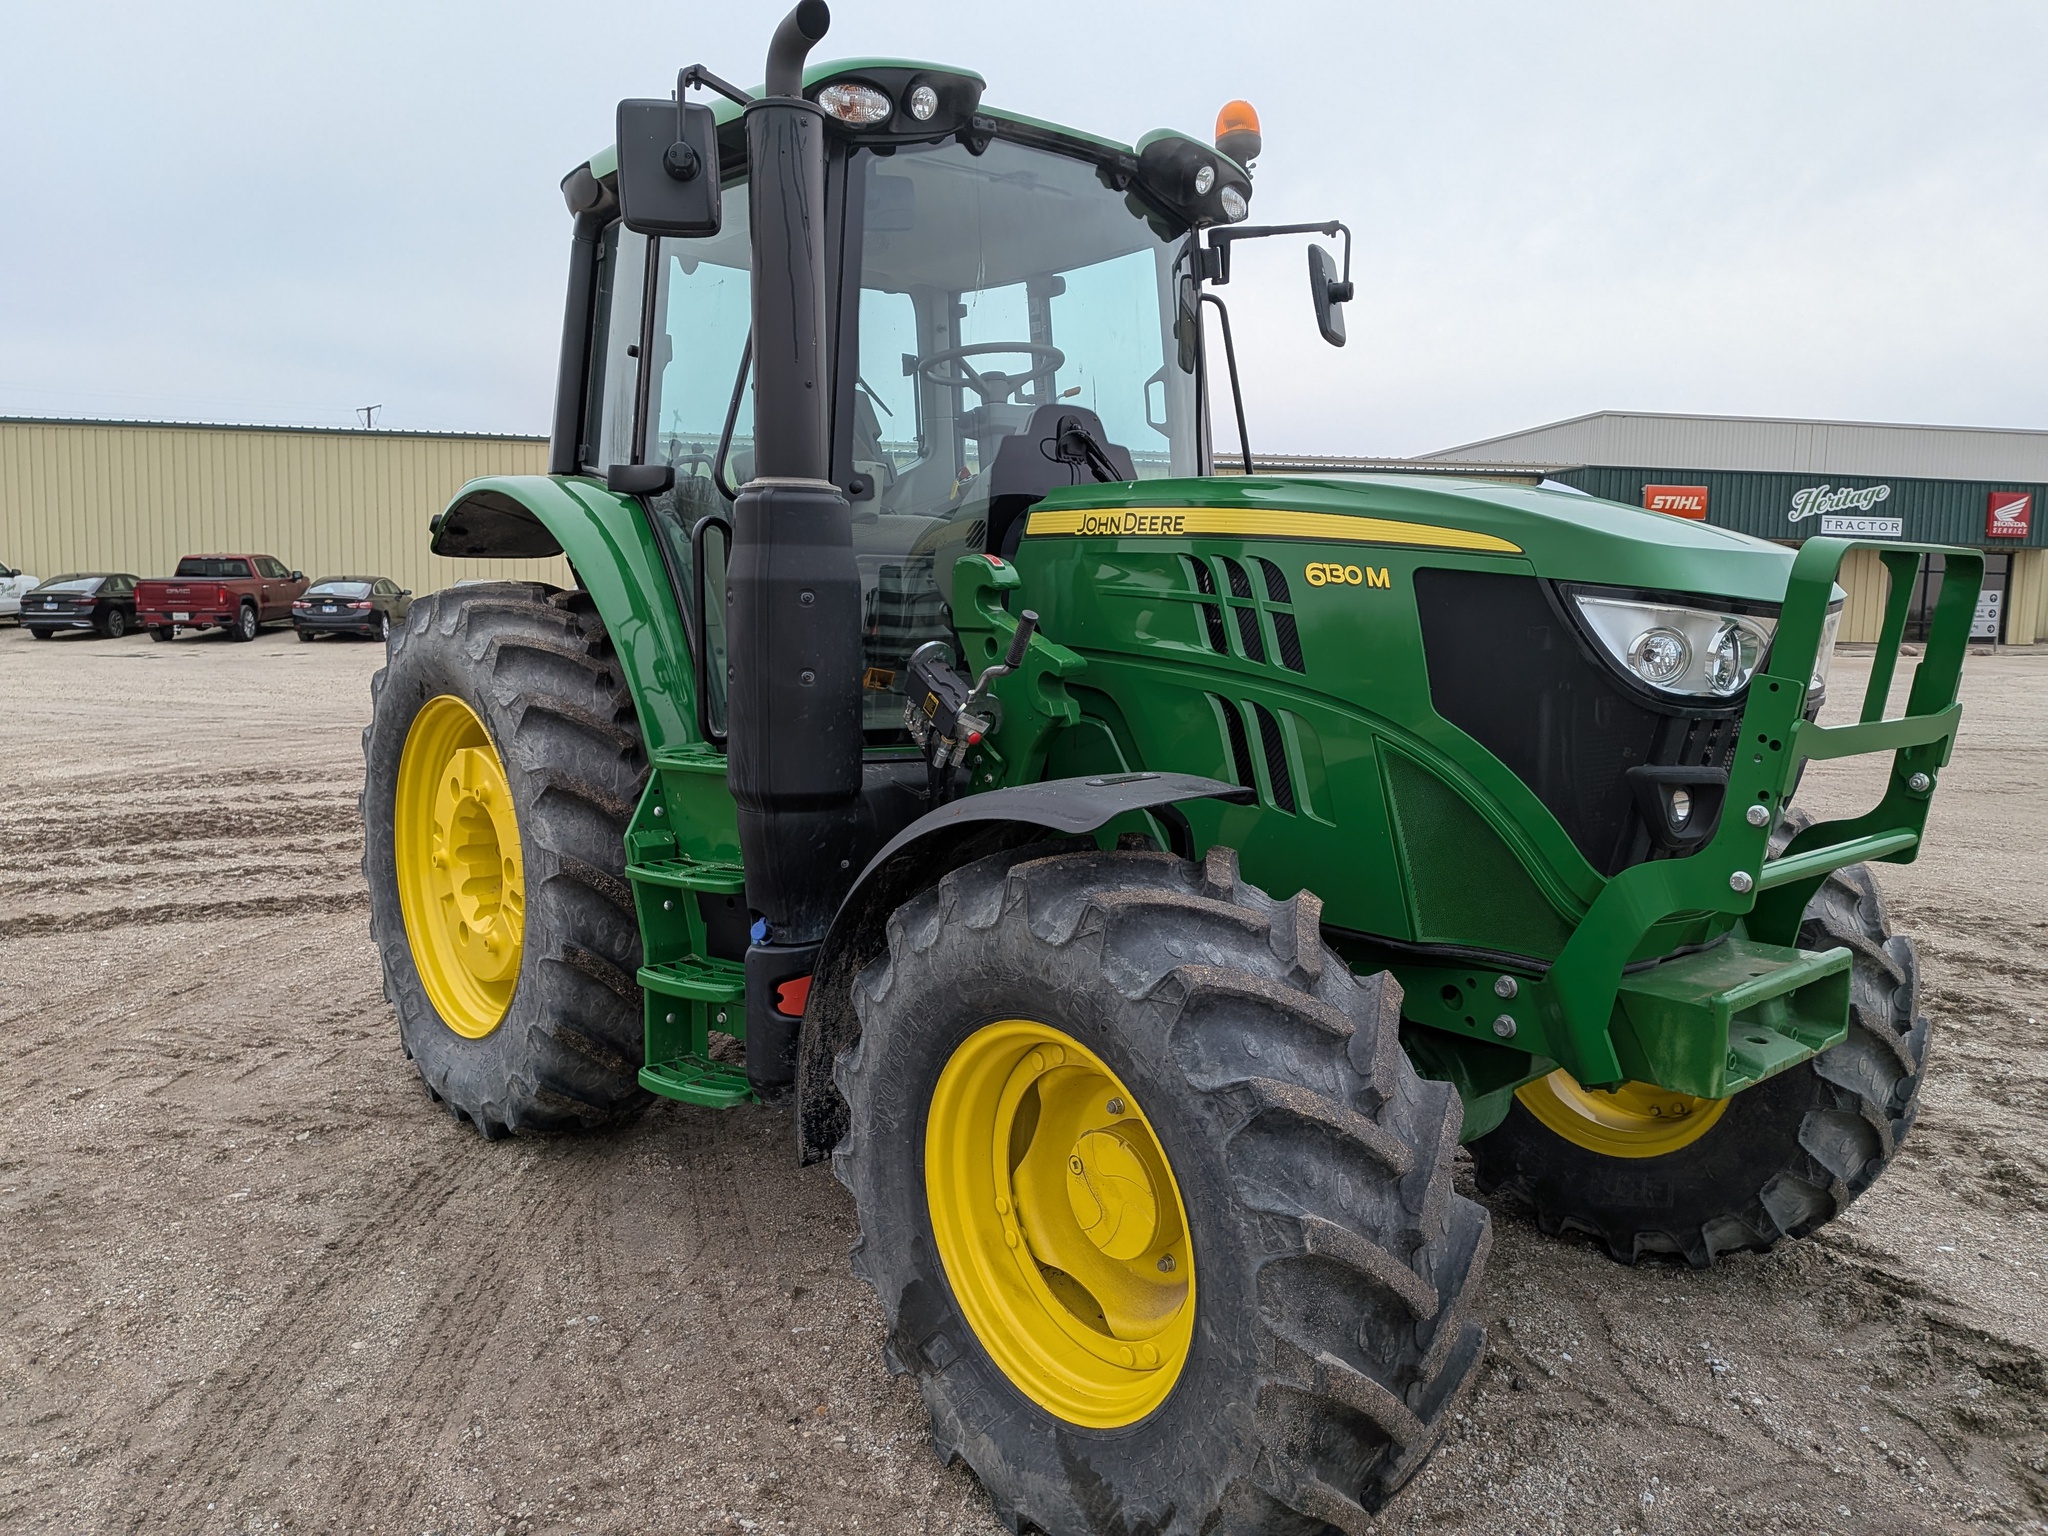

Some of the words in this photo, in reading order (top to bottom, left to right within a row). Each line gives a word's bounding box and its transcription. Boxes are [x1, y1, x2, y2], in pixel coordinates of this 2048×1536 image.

[1650, 495, 1703, 510] STIHL
[1788, 485, 1890, 522] Heritage
[1076, 513, 1121, 534] JOHN
[1123, 512, 1186, 533] DEERE
[1824, 520, 1900, 532] TRACTOR
[1993, 520, 2028, 528] HONDA
[1992, 527, 2028, 535] SERVICE
[1304, 561, 1363, 588] 6130
[1365, 566, 1391, 589] M
